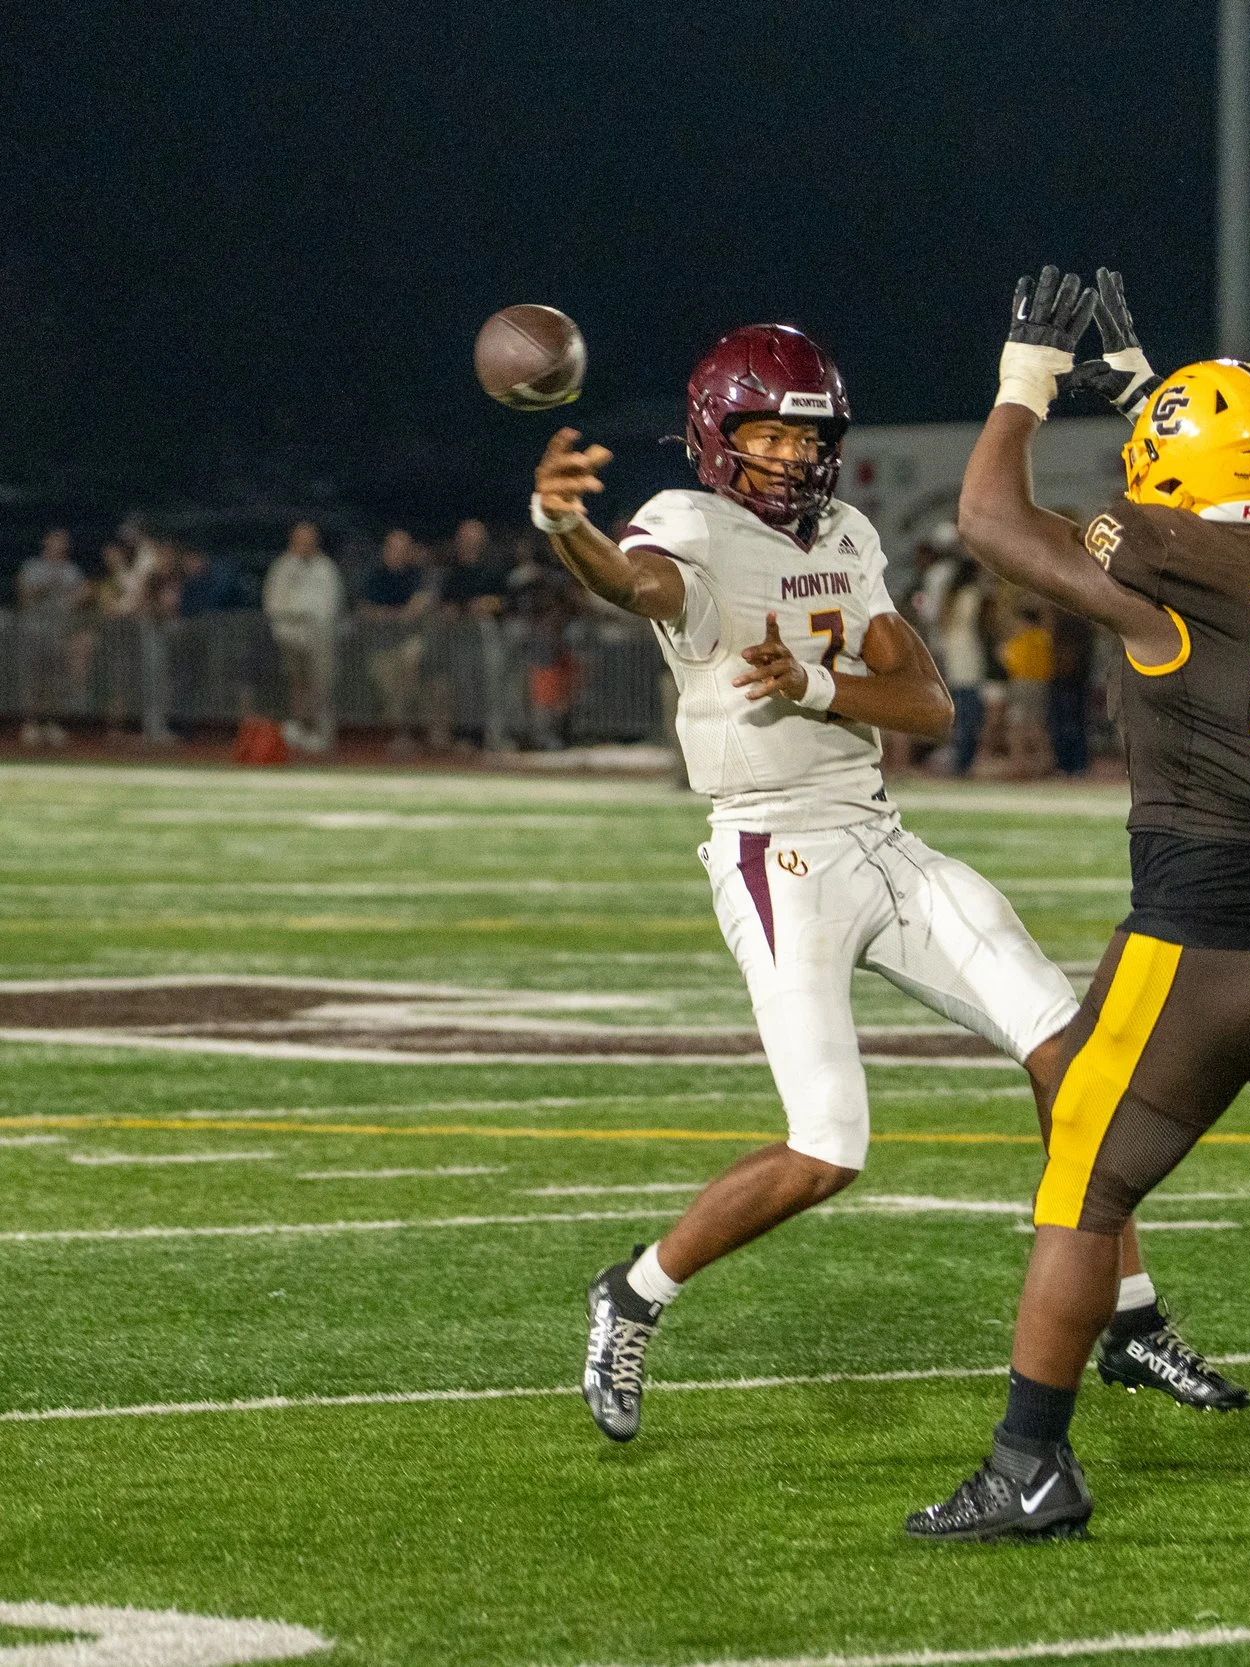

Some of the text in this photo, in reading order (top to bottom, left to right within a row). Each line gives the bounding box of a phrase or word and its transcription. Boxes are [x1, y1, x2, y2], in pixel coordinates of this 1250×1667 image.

[791, 397, 828, 410] MONTINI
[781, 571, 852, 600] MONTINI
[808, 607, 847, 673] 7
